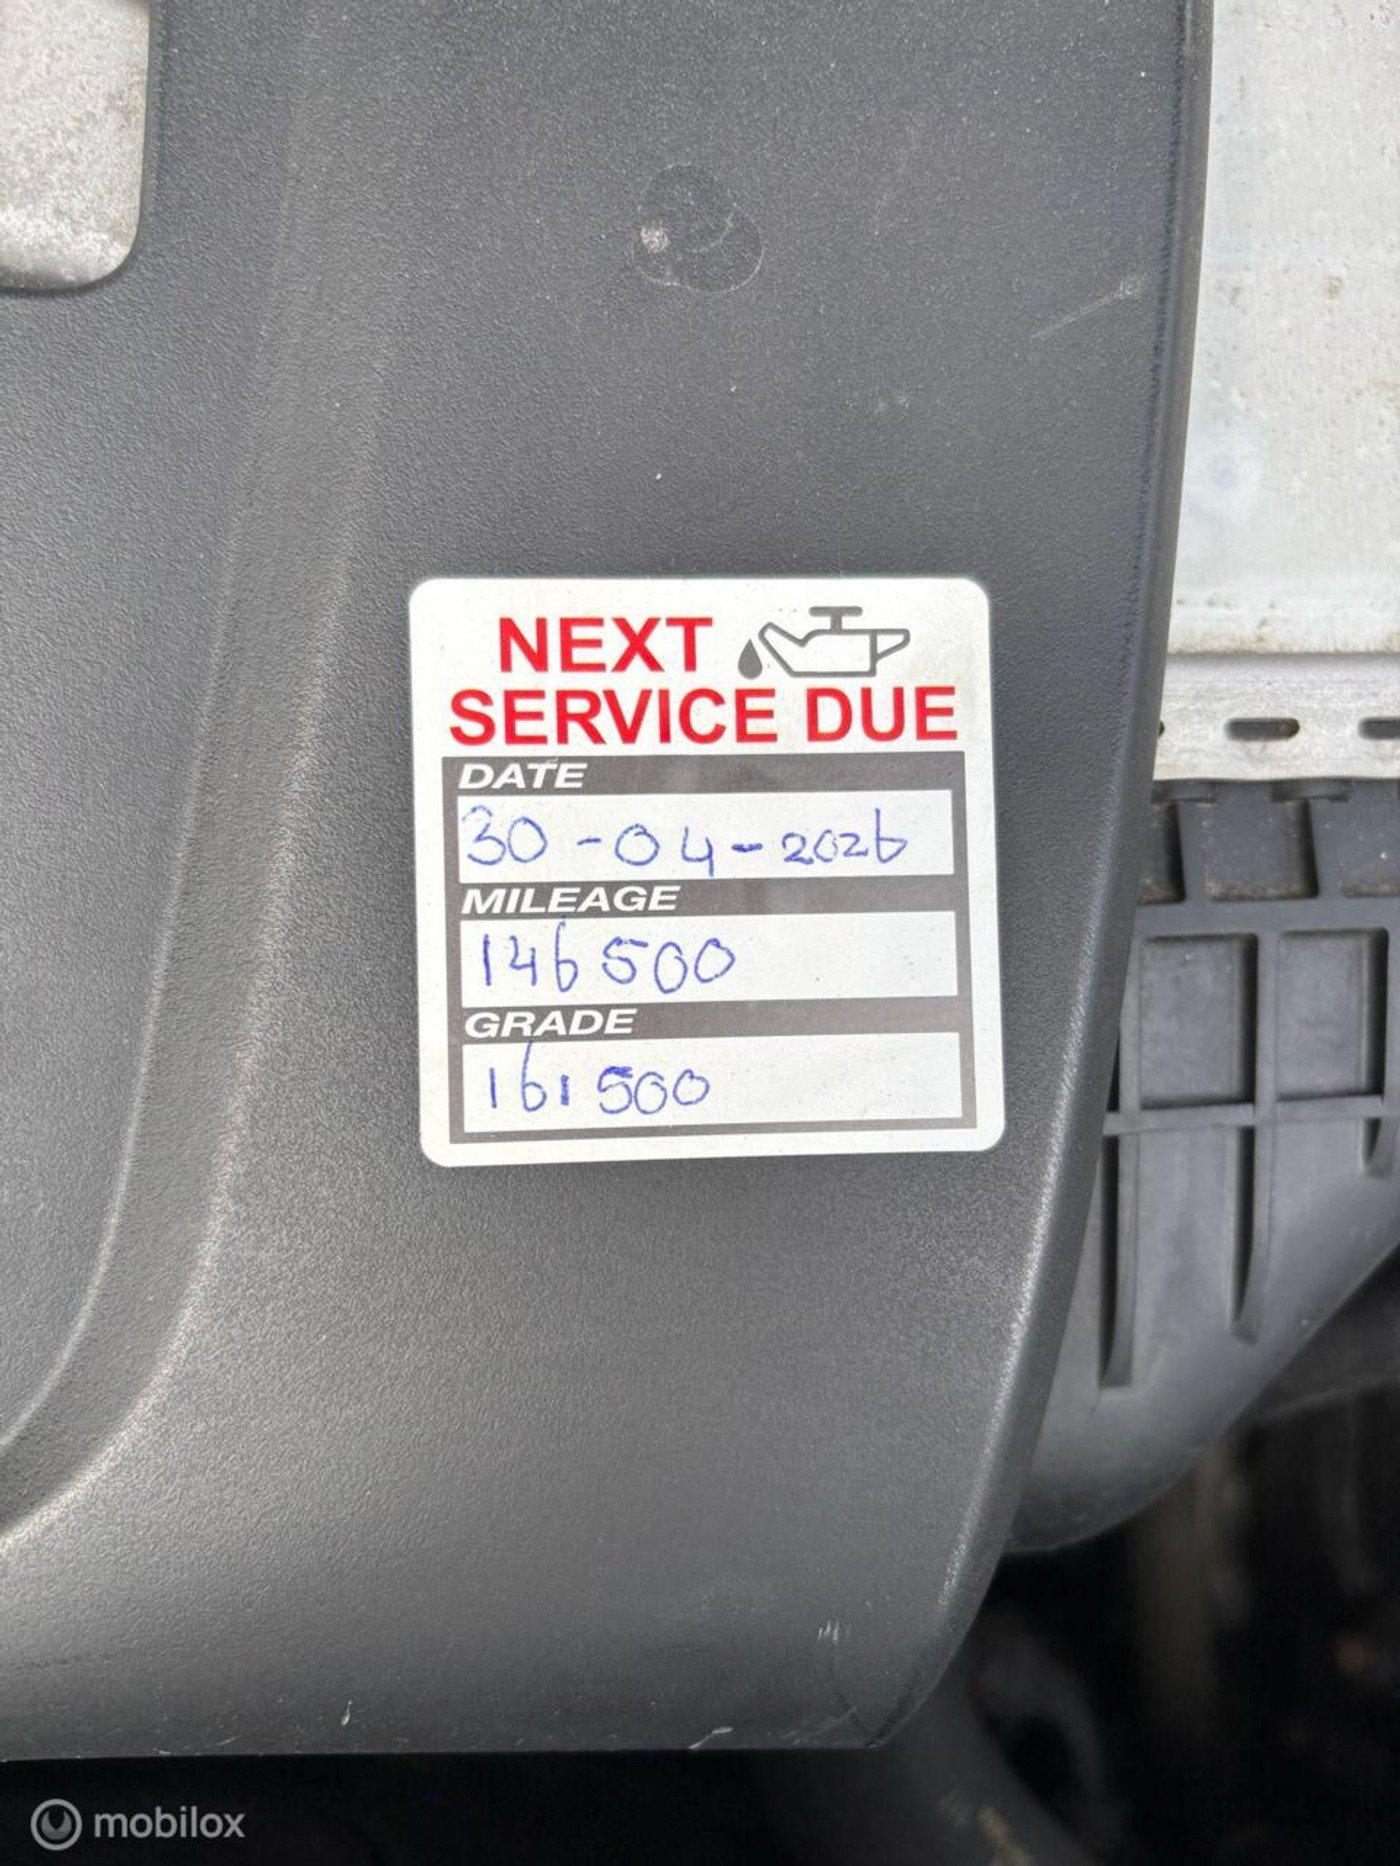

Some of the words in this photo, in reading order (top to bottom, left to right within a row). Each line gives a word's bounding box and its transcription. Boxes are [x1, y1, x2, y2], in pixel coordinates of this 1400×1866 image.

[498, 616, 713, 673] NEXT
[449, 687, 778, 746] SERVICE
[806, 685, 958, 742] DUE
[458, 762, 588, 789] DATE
[461, 885, 681, 915] MILEAGE
[464, 1007, 638, 1038] GRADE
